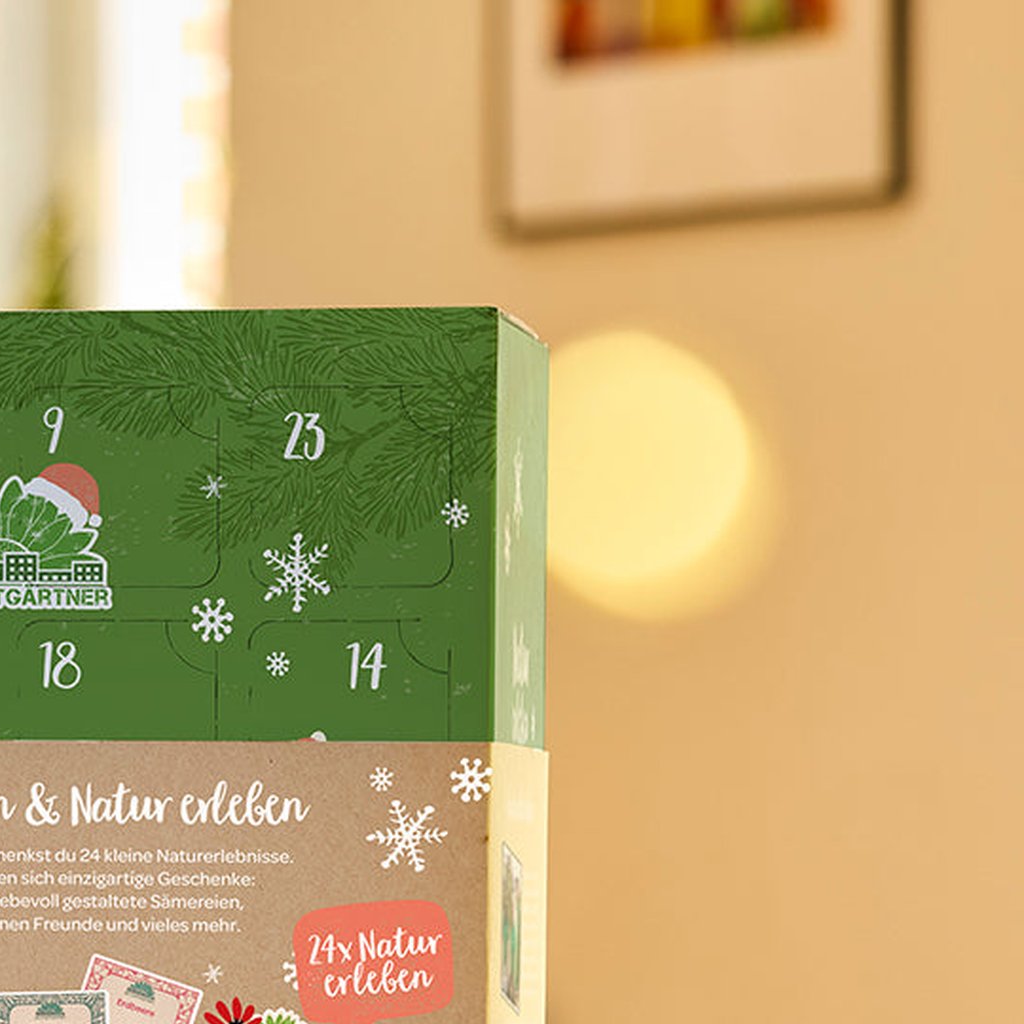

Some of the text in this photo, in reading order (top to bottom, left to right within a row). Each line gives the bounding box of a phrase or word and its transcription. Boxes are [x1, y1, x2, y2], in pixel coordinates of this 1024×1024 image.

[43, 406, 64, 454] 9
[283, 412, 326, 460] 23
[39, 641, 82, 689] 18
[346, 643, 387, 689] 14
[25, 782, 61, 826] &
[71, 782, 174, 826] Natur
[180, 780, 311, 826] erleben
[54, 848, 76, 863] du
[79, 849, 101, 863] 24
[103, 848, 153, 863] kleine
[156, 849, 294, 864] Naturerlebnisse.
[22, 870, 54, 886] sich
[57, 871, 154, 889] einzigartige
[157, 871, 255, 886] Geschenke:
[62, 894, 147, 912] gestaltete
[150, 894, 244, 911] Sämereien,
[32, 917, 103, 932] Freunde
[106, 917, 138, 932] und
[141, 918, 189, 932] vieles
[192, 921, 240, 933] mehr.
[308, 927, 443, 965] 24x Natur
[324, 960, 433, 997] erleben
